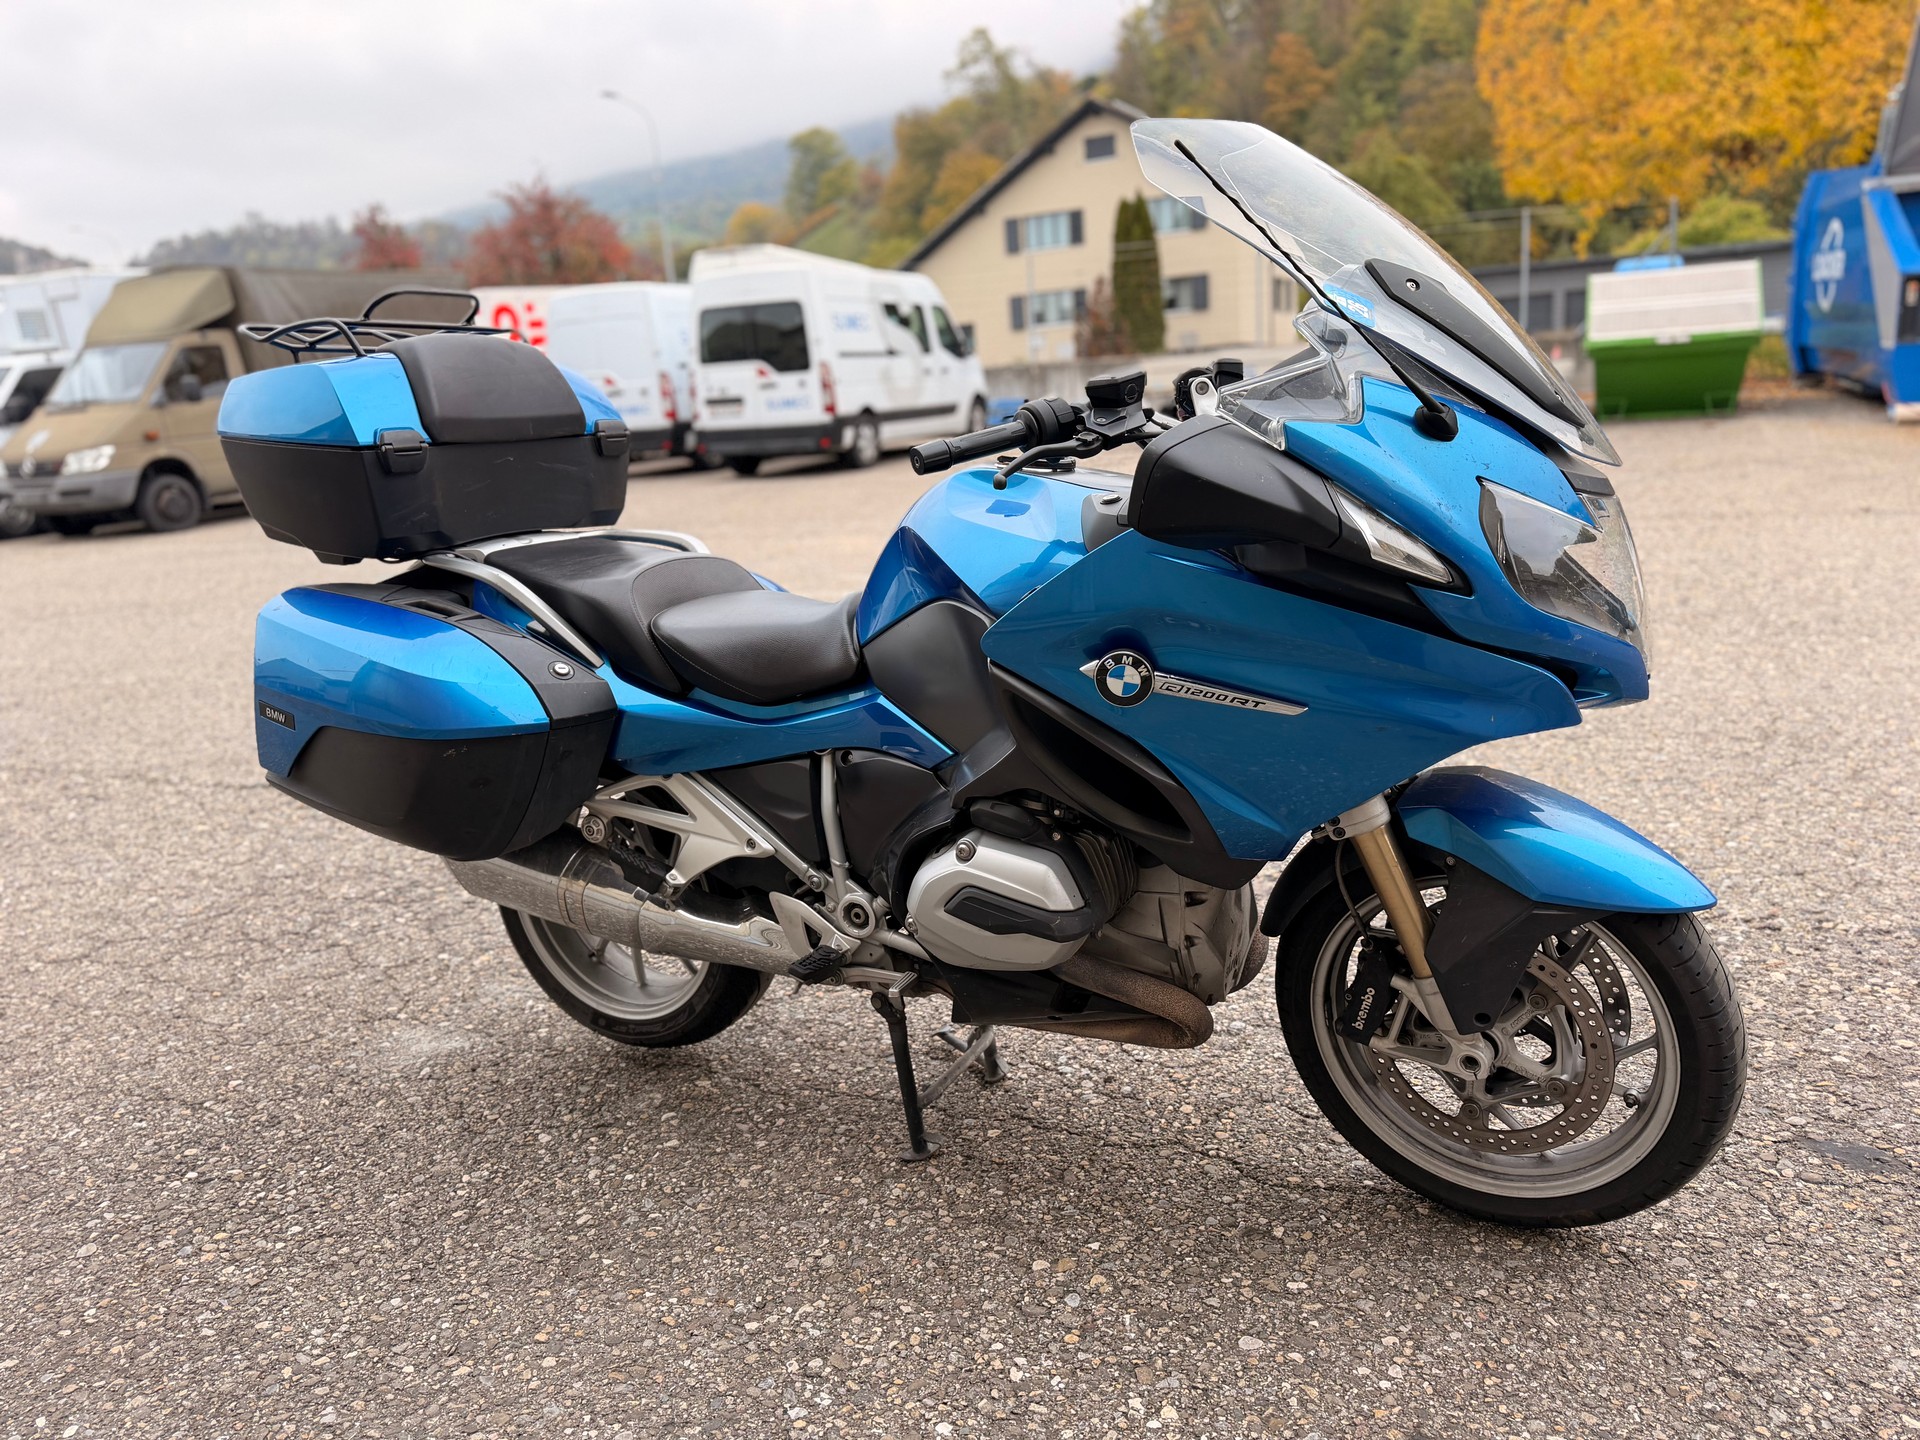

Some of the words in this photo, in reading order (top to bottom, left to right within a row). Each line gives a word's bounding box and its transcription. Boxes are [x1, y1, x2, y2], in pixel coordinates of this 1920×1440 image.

[1103, 655, 1150, 677] BMW
[265, 707, 286, 723] BMW
[1351, 987, 1375, 1030] brembo
